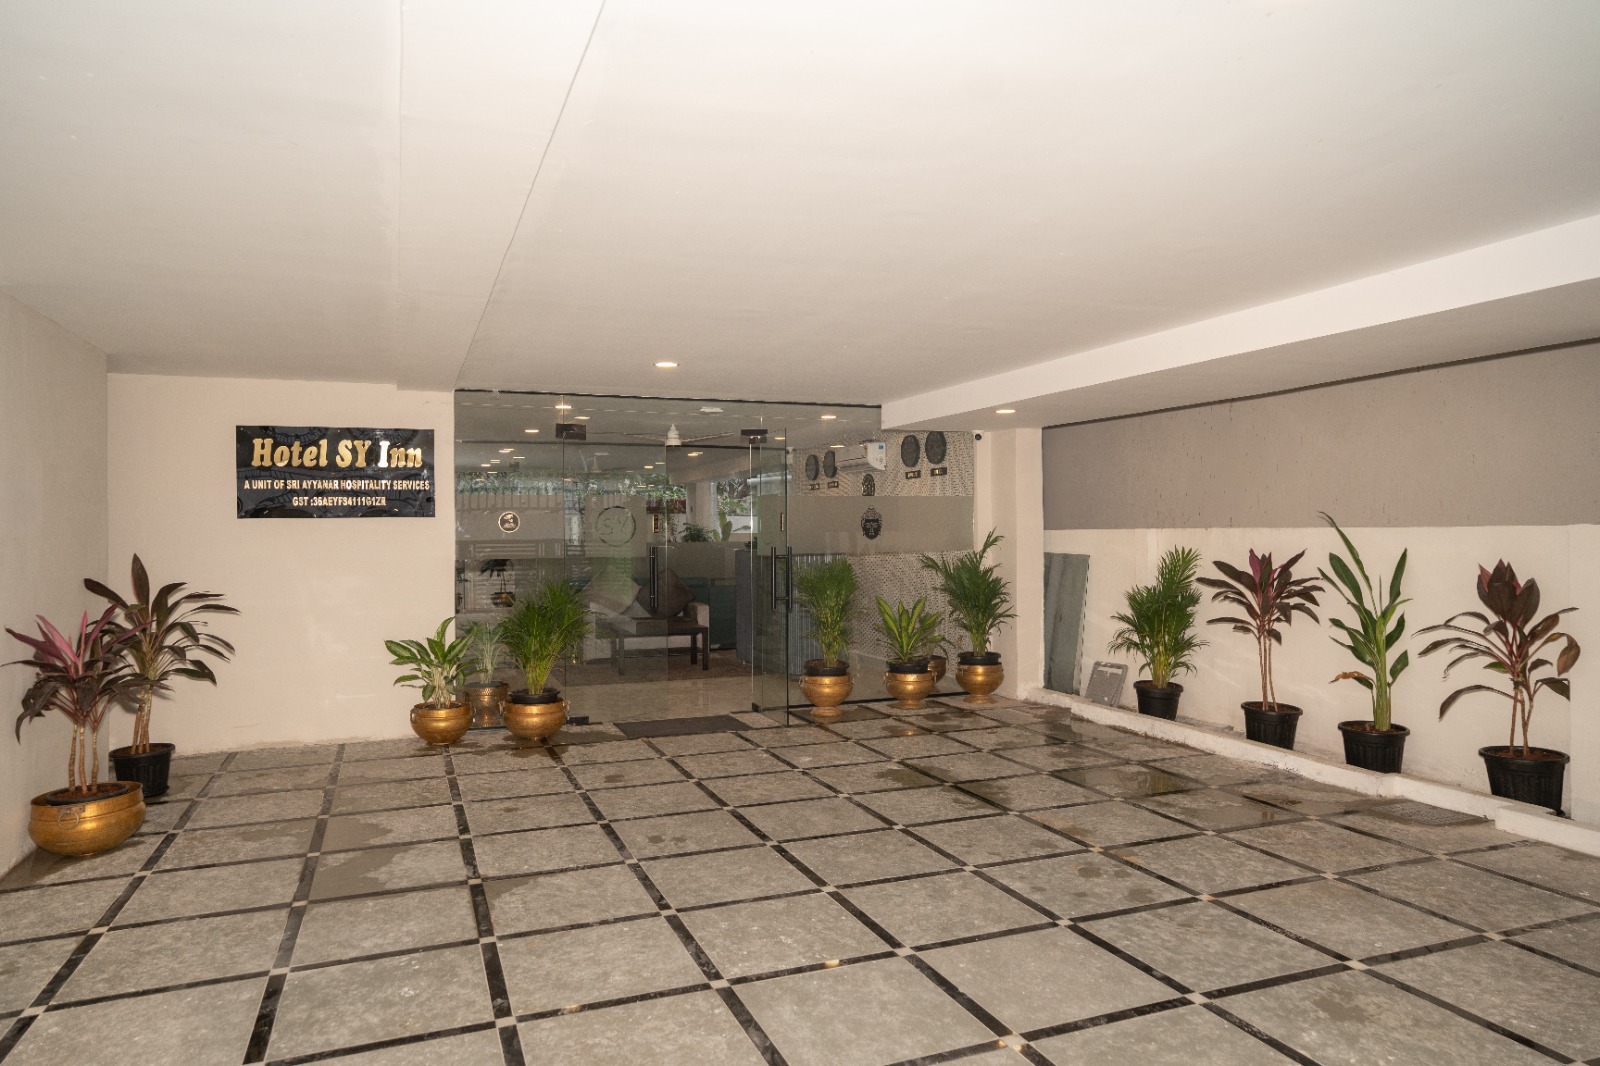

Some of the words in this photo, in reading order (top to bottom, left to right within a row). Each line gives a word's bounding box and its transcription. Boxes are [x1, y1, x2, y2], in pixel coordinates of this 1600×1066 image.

[251, 438, 328, 467] Hotel
[335, 439, 372, 468] SY
[378, 440, 422, 468] Inn
[244, 480, 251, 490] A
[252, 480, 272, 490] UNIT
[274, 480, 285, 490] OF
[286, 480, 300, 490] SRI
[302, 480, 339, 490] AYYANAR
[341, 480, 391, 490] HOSPITALITY
[392, 480, 430, 490] SERVICES
[293, 496, 309, 506] GST
